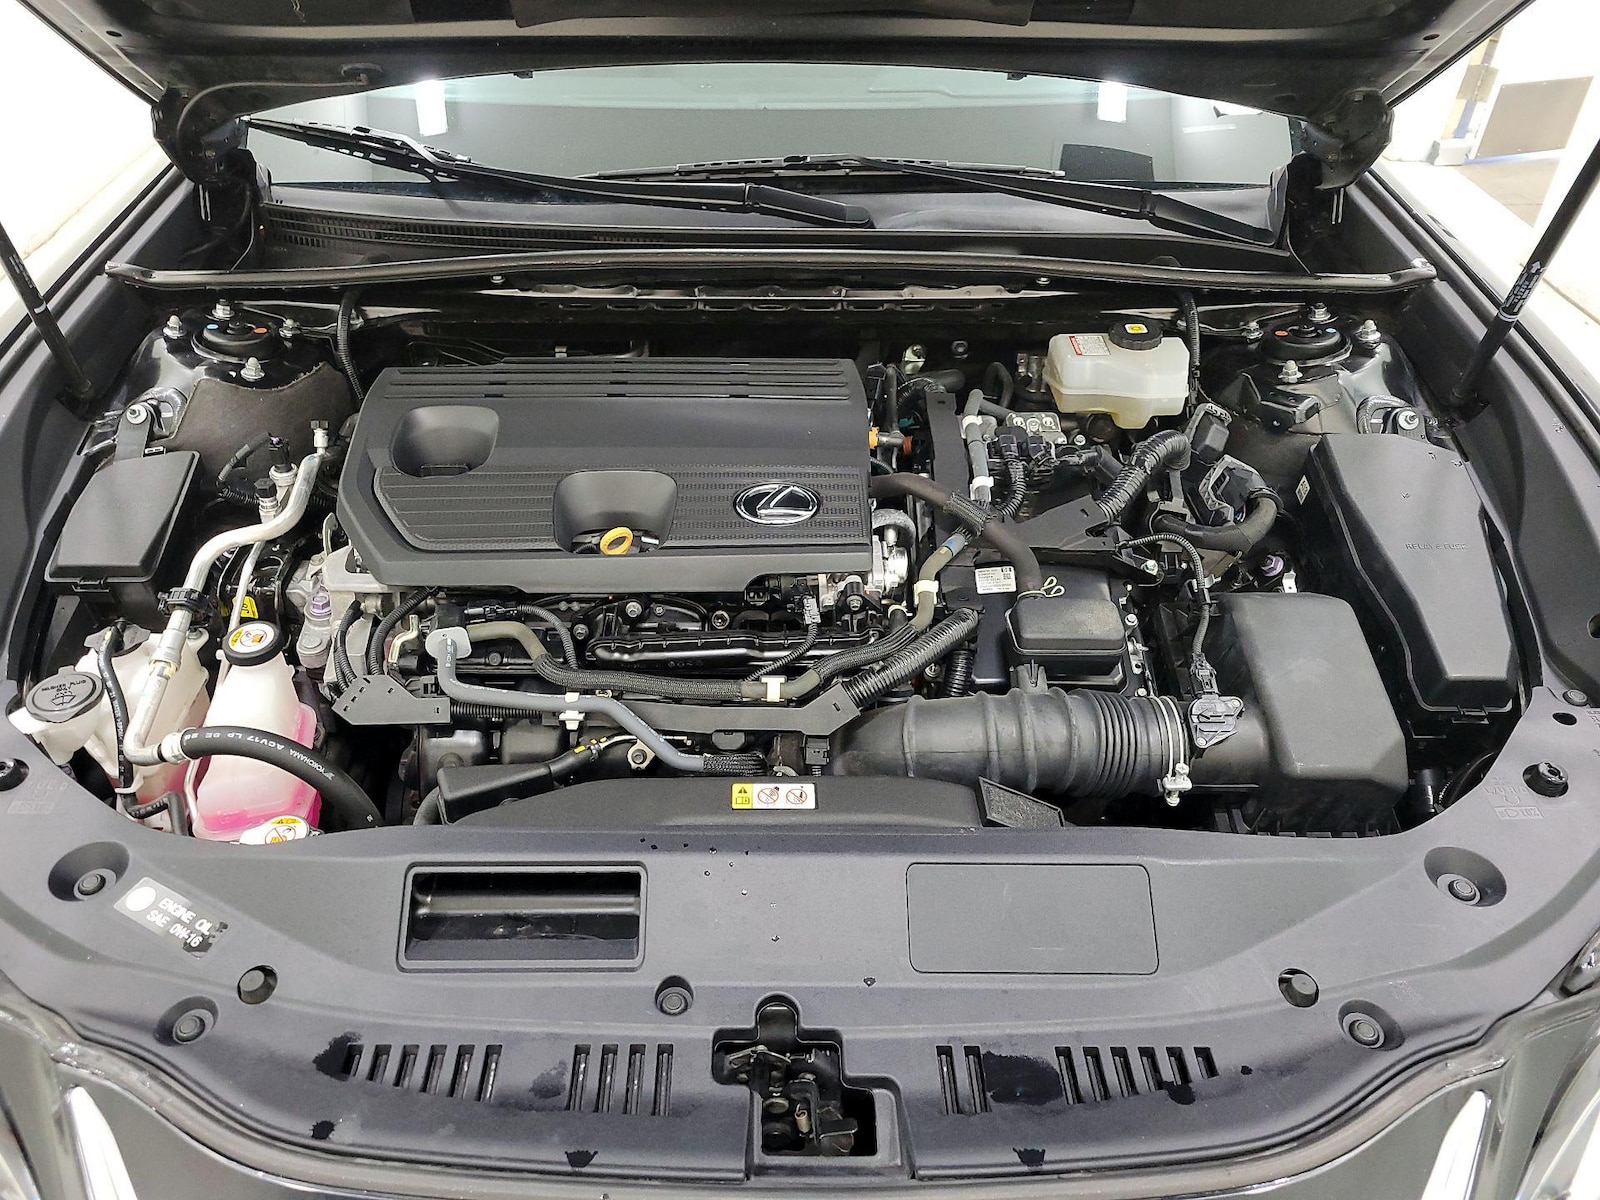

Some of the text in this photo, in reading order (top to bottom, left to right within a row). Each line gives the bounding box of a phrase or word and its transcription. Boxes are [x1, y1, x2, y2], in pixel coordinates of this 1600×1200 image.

[246, 736, 285, 750] ACV17
[289, 748, 329, 777] YOKOHAMA
[146, 909, 204, 947] SAE 0W-16
[158, 897, 213, 936] ENGINE OIL
